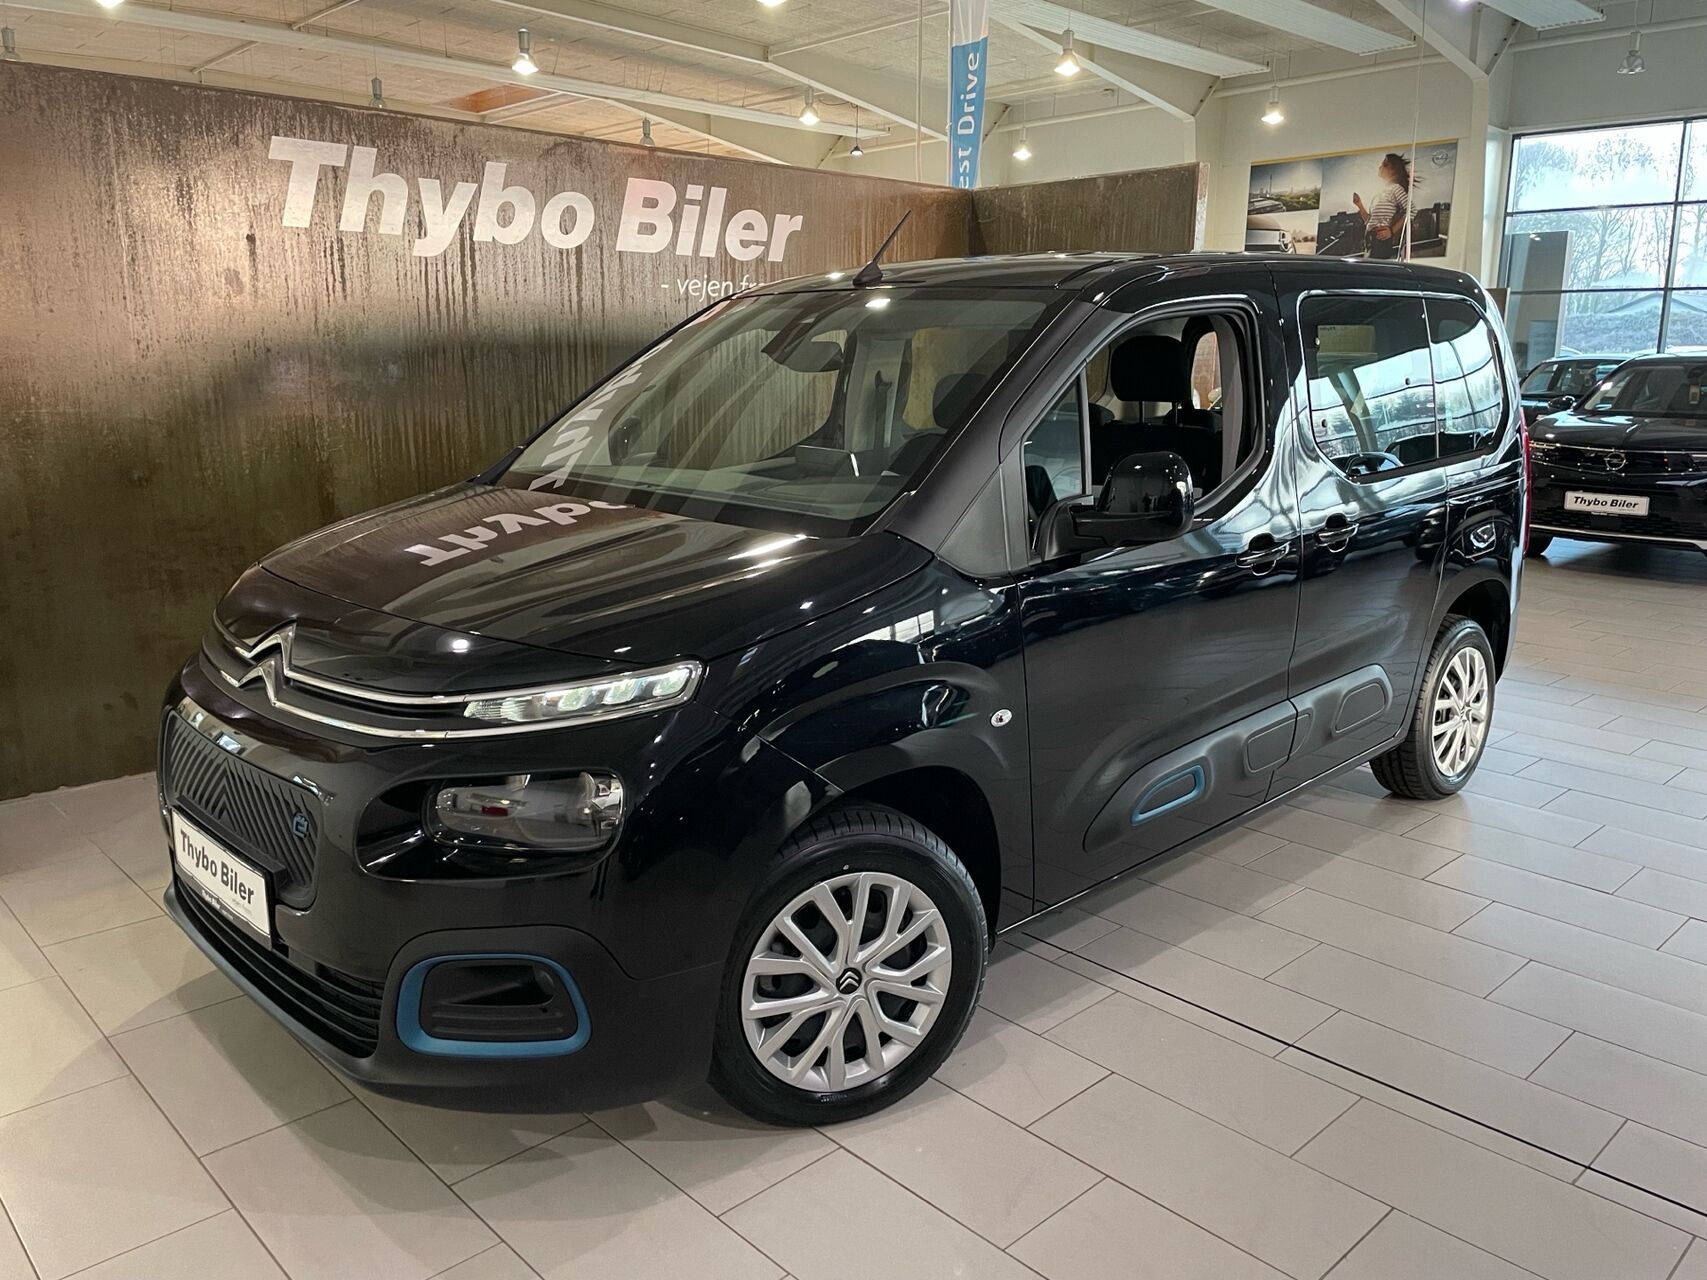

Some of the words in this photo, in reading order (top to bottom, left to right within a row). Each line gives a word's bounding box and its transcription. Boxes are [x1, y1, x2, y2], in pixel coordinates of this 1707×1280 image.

[957, 52, 979, 135] Drive
[268, 136, 595, 257] Thybo
[616, 177, 804, 262] Biler
[677, 274, 733, 302] vejen
[740, 274, 765, 290] fr
[1574, 496, 1608, 507] Thybo
[1610, 499, 1639, 508] Biler
[180, 829, 218, 877] Thybo
[220, 861, 254, 904] Biler
